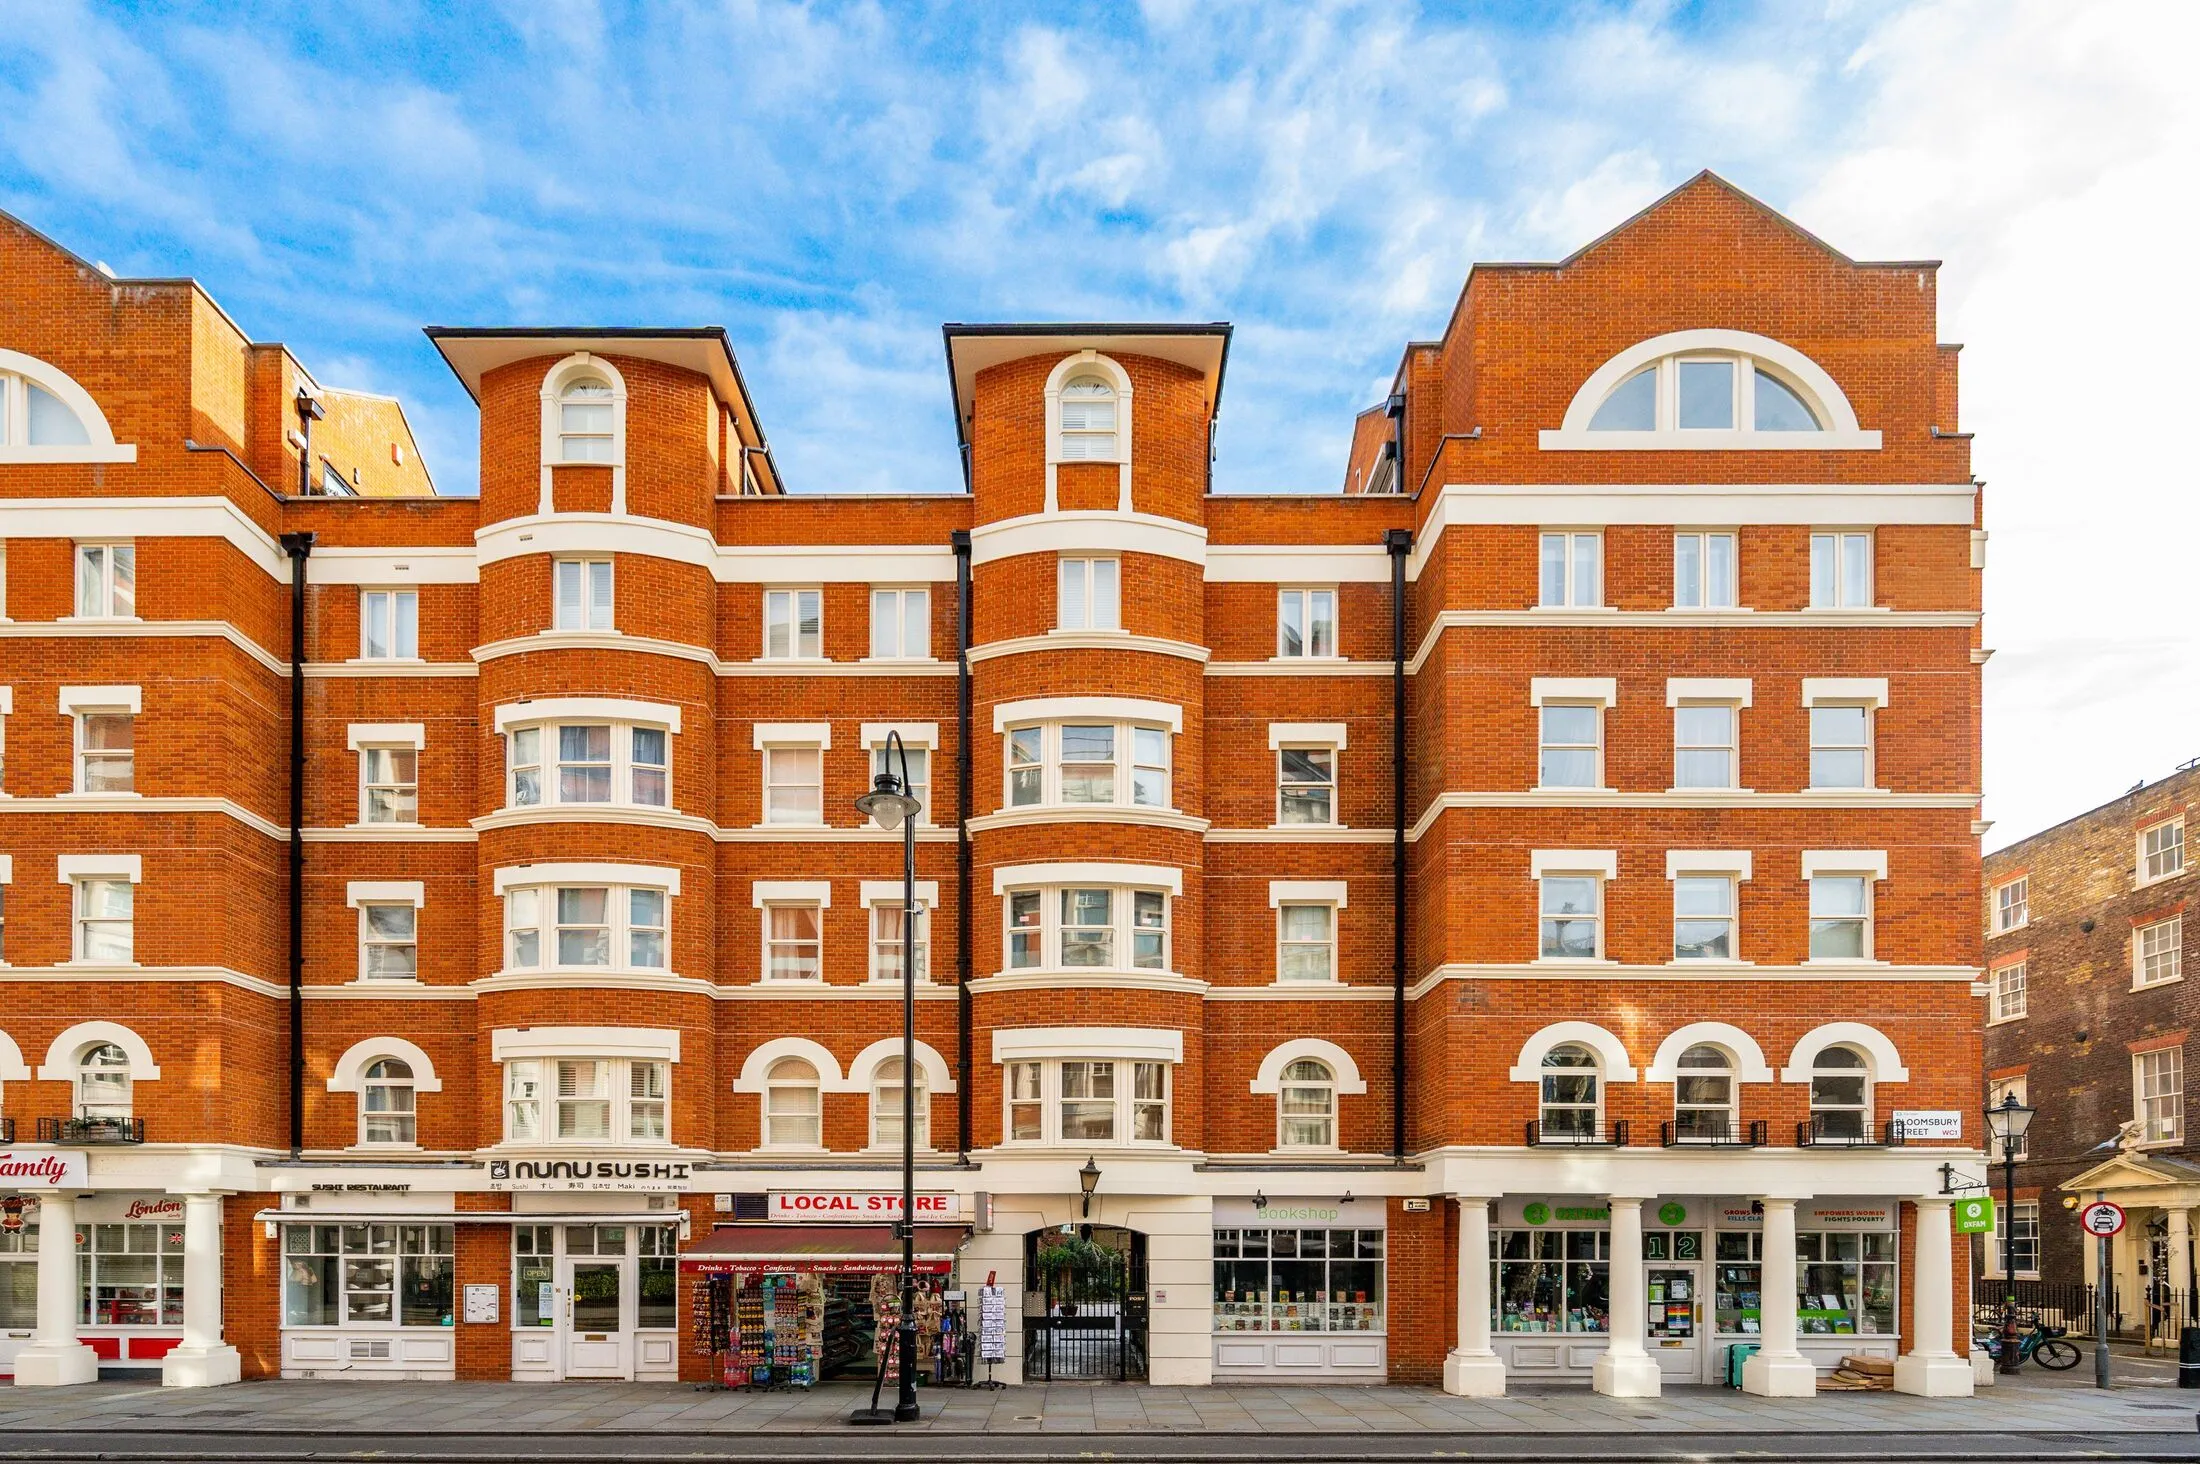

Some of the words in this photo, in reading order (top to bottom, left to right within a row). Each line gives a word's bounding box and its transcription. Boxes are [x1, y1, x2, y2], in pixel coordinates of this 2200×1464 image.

[597, 1162, 689, 1179] SUSHI
[125, 1200, 182, 1219] London
[780, 1196, 859, 1210] LOCAL
[1258, 1207, 1338, 1222] Bookshop
[1555, 1207, 1609, 1220] OXFAM
[1963, 1220, 1986, 1228] OXFAM
